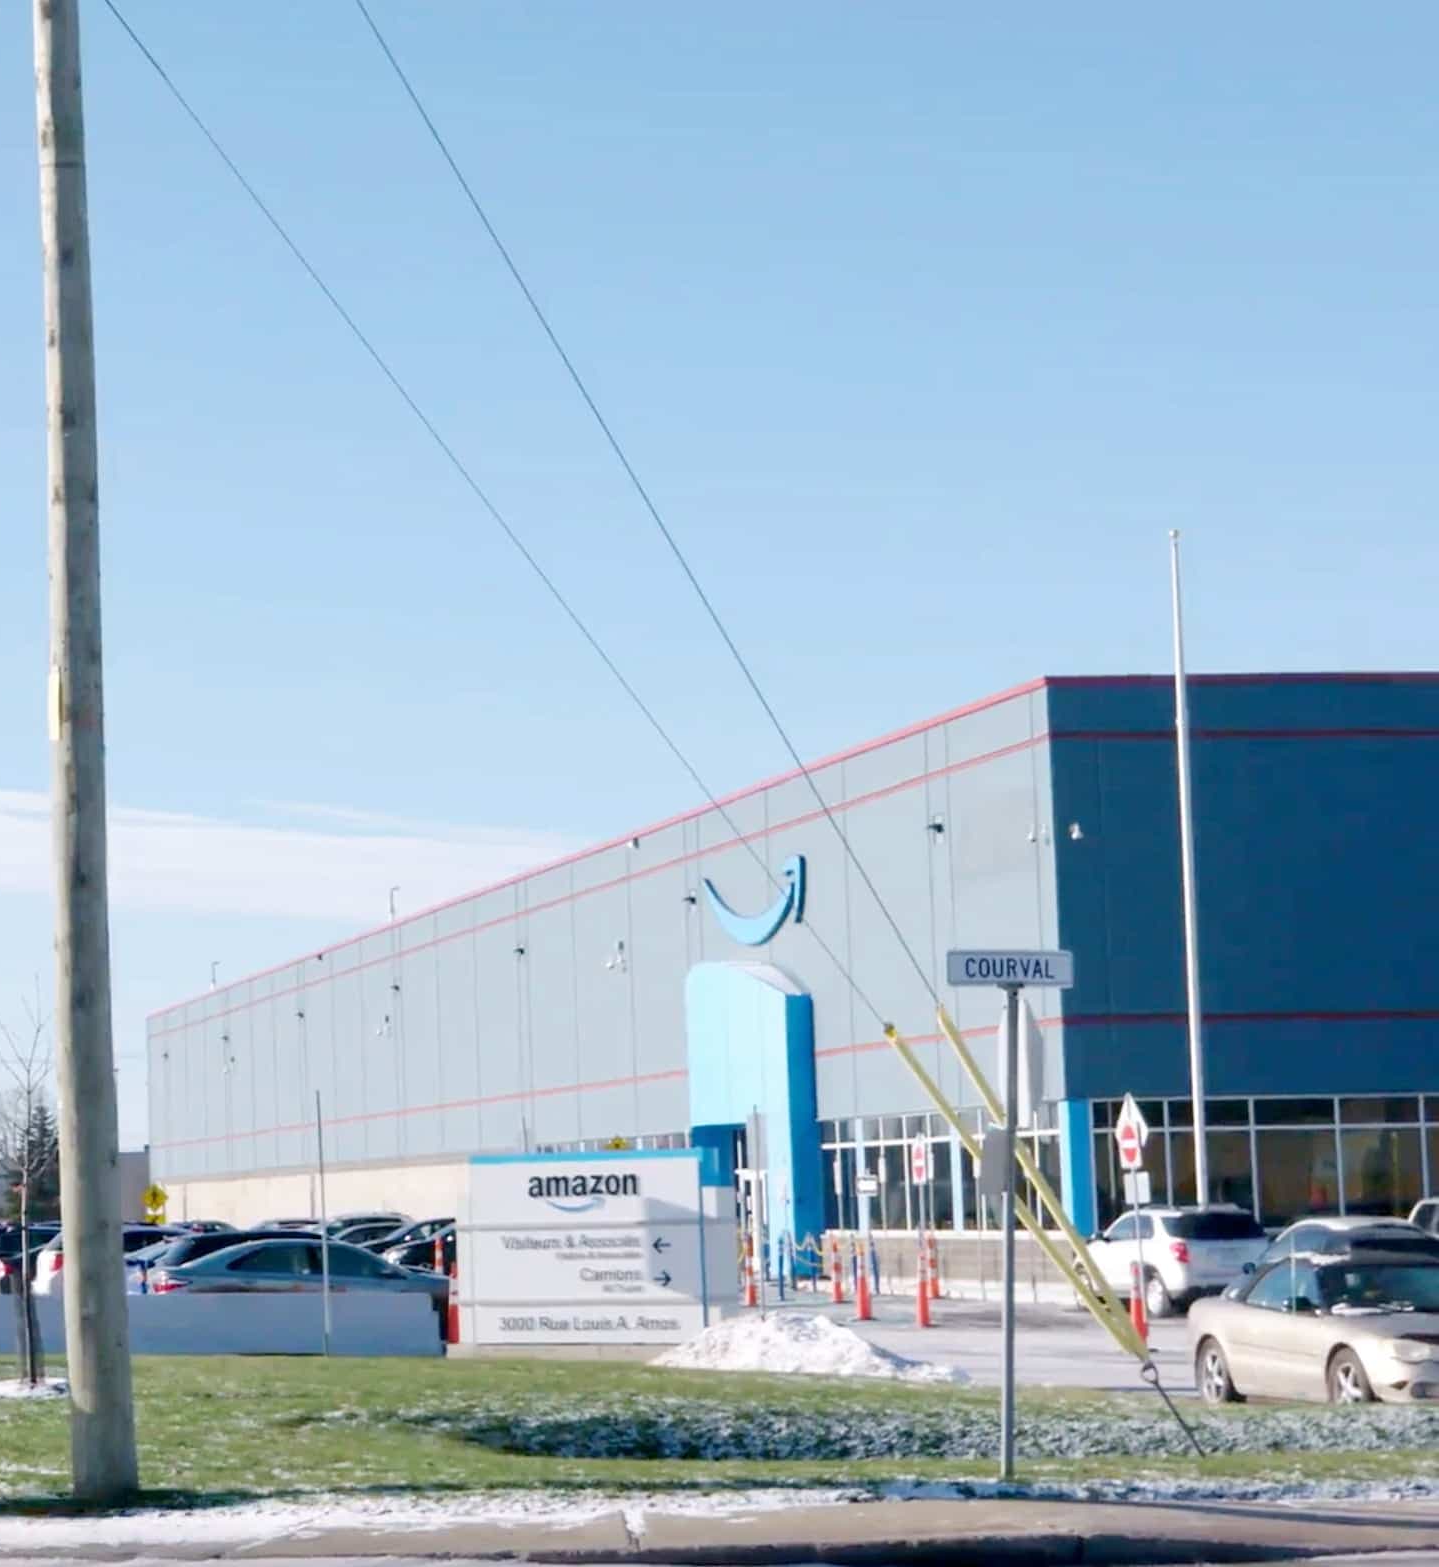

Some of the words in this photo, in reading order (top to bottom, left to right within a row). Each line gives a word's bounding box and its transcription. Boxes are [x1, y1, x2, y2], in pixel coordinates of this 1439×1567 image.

[965, 957, 1055, 980] COURVAL
[528, 1173, 639, 1198] amazon
[539, 1316, 569, 1331] Rue
